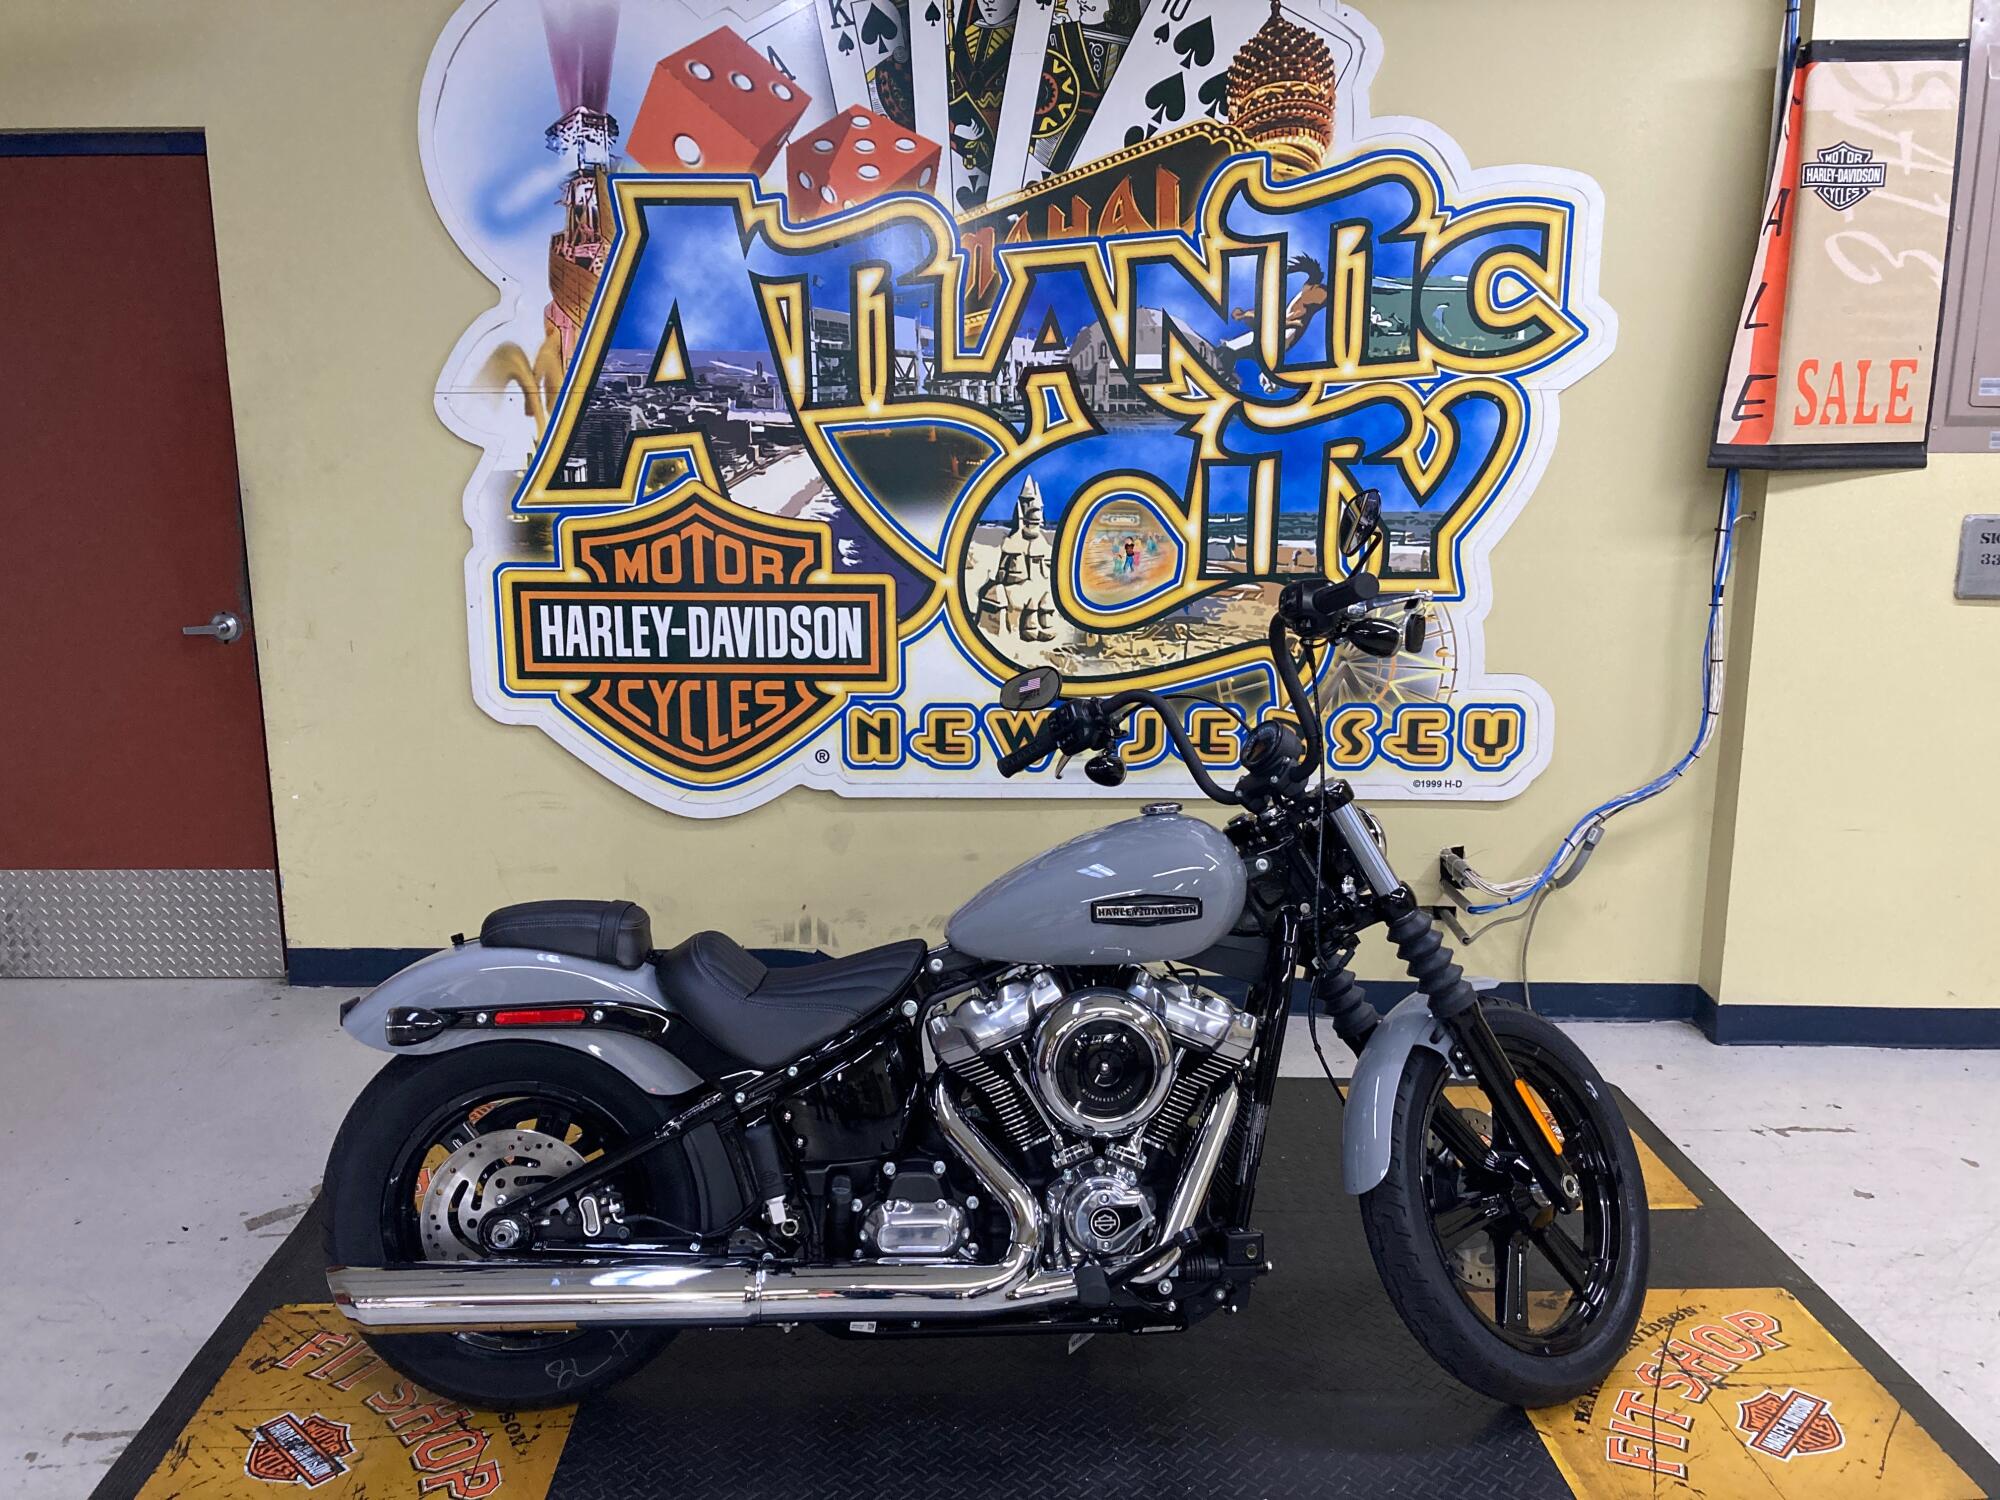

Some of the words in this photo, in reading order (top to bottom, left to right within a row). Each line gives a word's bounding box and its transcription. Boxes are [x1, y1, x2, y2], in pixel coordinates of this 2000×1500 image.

[1806, 167, 1881, 182] HARLEY-DAVIDSON
[1825, 147, 1863, 163] MOTOR
[1823, 186, 1860, 205] CYCLES
[512, 150, 1590, 610] ATLANTIC
[1793, 358, 1918, 426] SALE
[614, 521, 784, 585] MOTOR
[948, 378, 1532, 692] CITY
[539, 604, 863, 660] HARLEY-DAVIDSON
[617, 679, 786, 752] CYCLES
[1119, 706, 1527, 768] JESEY
[1444, 779, 1463, 788] H-D
[1635, 1310, 1787, 1404] SHOP
[363, 1378, 503, 1500] SHOP
[1606, 1388, 1693, 1479] FIT
[1748, 1399, 1783, 1431] MOTOR
